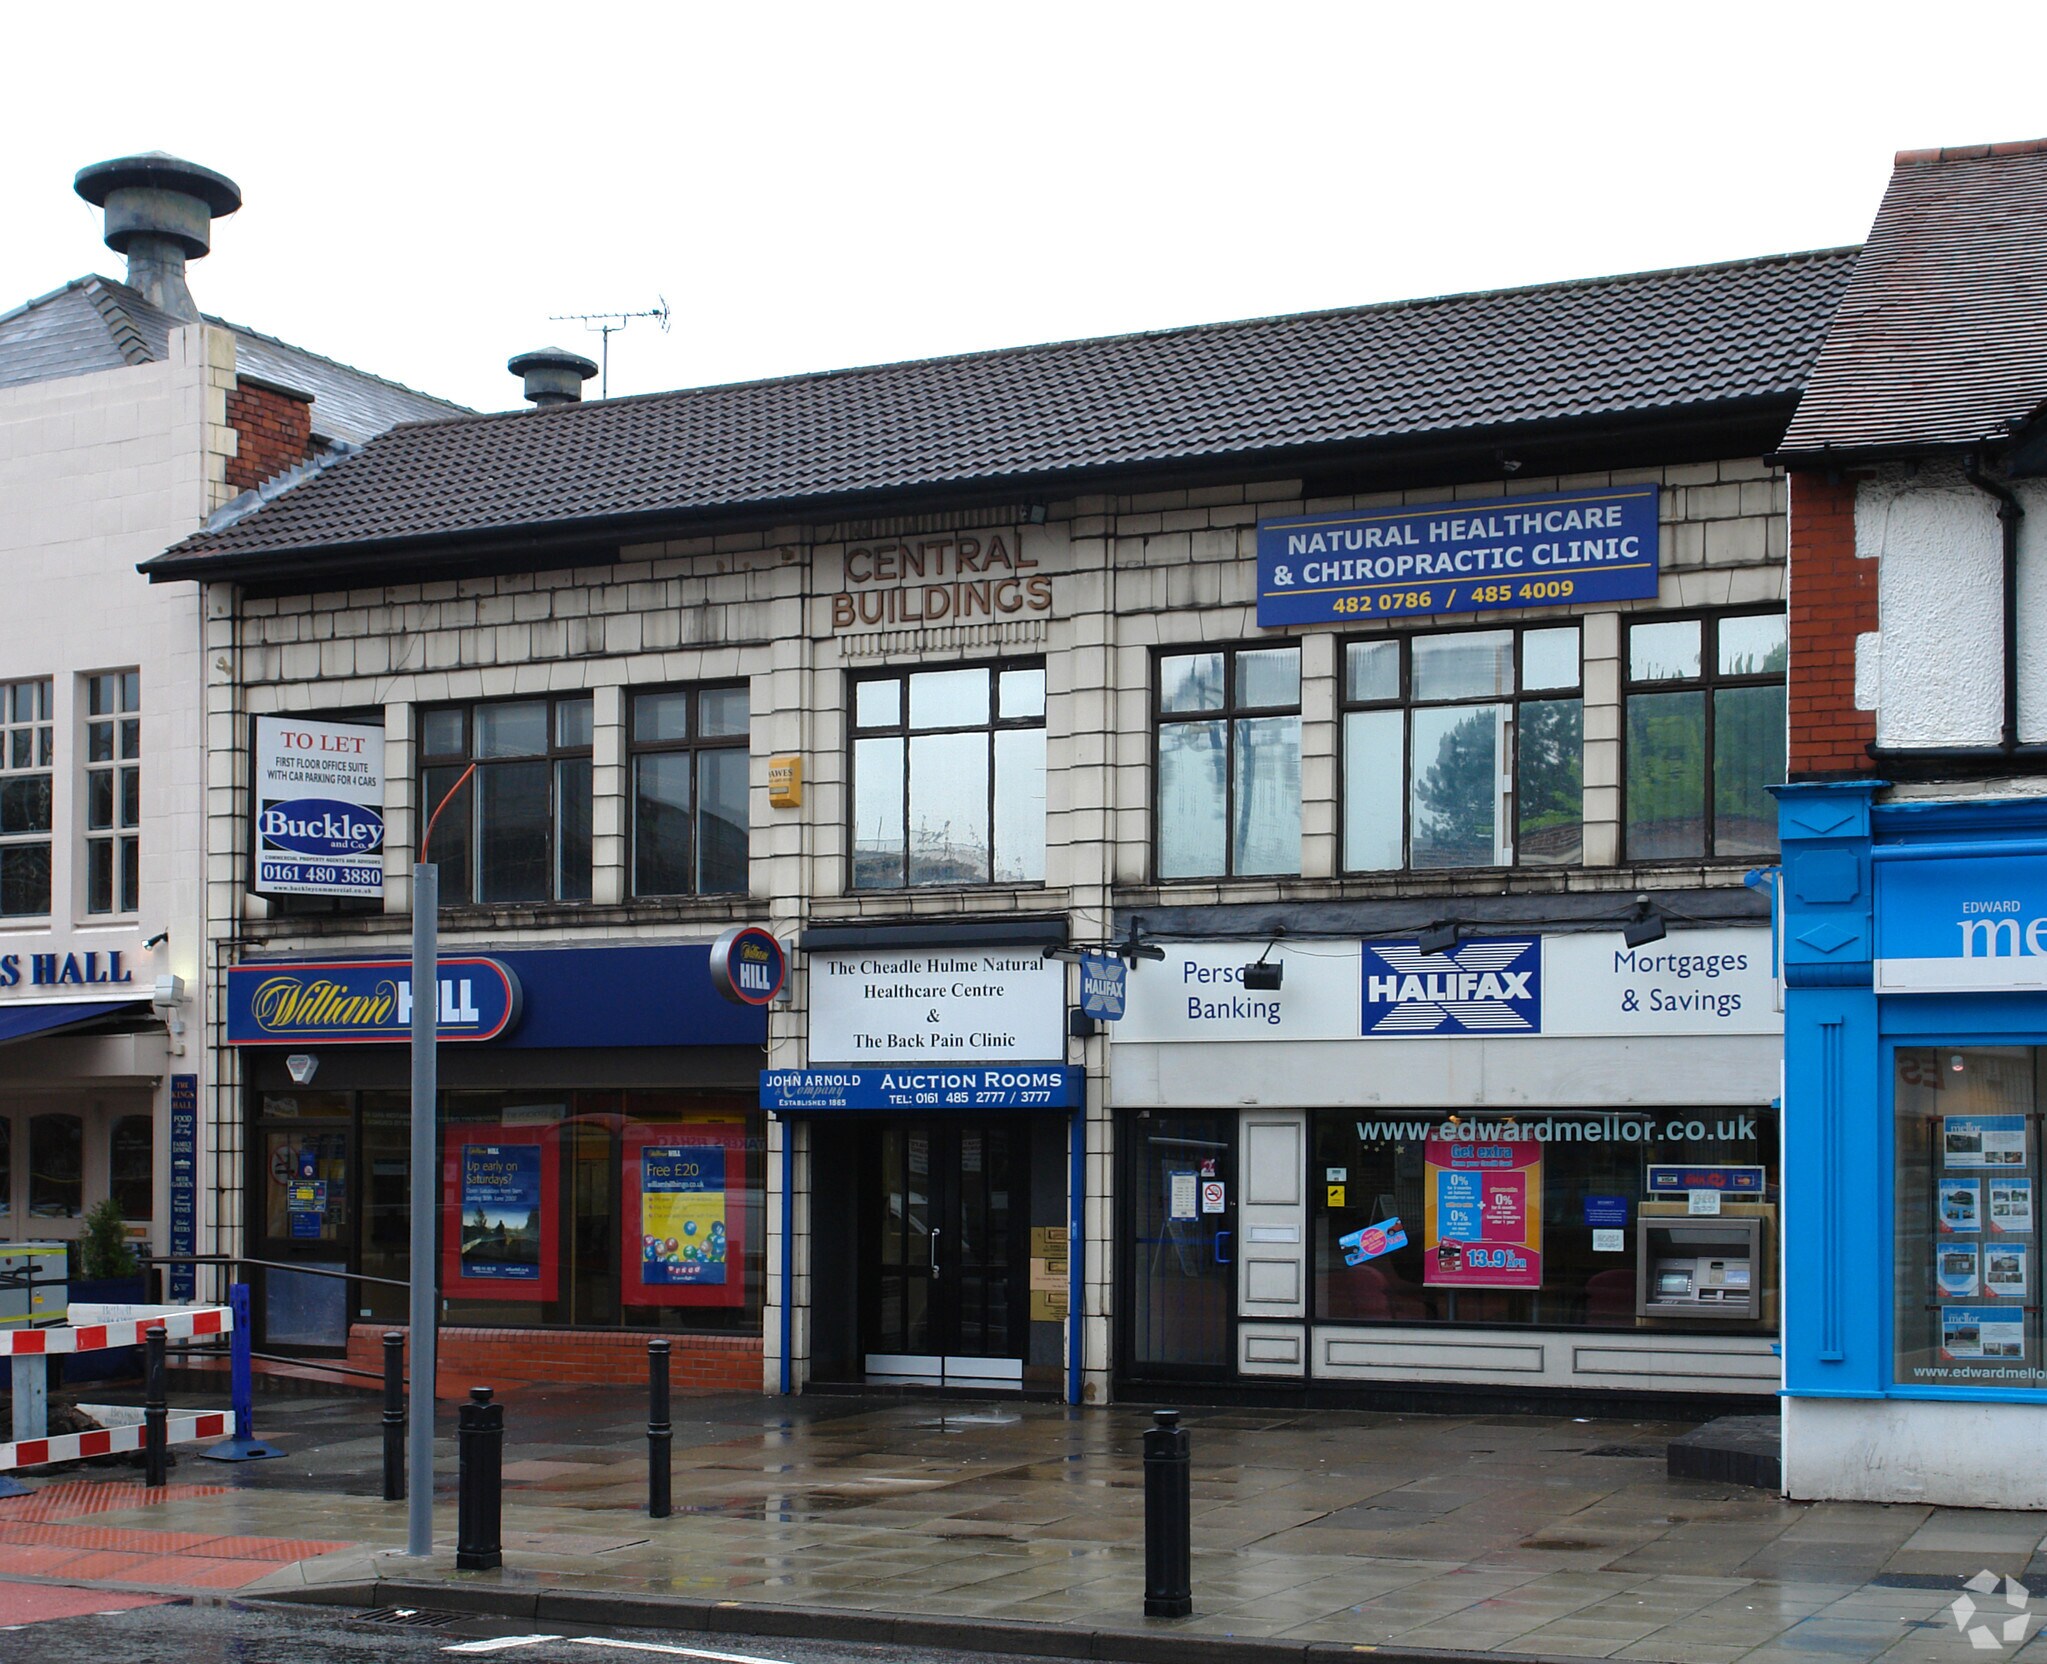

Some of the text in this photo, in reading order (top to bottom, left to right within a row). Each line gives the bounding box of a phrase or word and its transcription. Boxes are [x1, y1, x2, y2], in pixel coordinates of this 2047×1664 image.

[1288, 505, 1622, 555] NATURAL HEALTHCARE
[844, 532, 1038, 582] CENTRAL
[1273, 536, 1639, 586] & CHIROPRACTIC CLINIC
[831, 575, 1053, 628] BUILDINGS
[1333, 580, 1574, 613] 482 0786 / 485 4009
[280, 732, 366, 753] TO LET
[276, 757, 368, 773] FIRST FLOOR OFFICE SUITE
[267, 770, 376, 787] WITH CAR PARKING FOR 4 CARS
[264, 810, 384, 849] Buckley
[331, 840, 367, 849] and Co.
[263, 864, 381, 885] 0161 480 3880
[273, 885, 372, 894] www.buckleycommercial.co.uk
[1962, 900, 2021, 914] EDWARD
[741, 941, 769, 961] William
[30, 951, 132, 985] HALL
[827, 957, 1045, 975] The Cheadle Hulme Natural
[1184, 959, 1283, 983] Persol
[1614, 950, 1748, 978] Mortgages
[740, 963, 771, 990] HILL
[863, 982, 1005, 1000] Healthcare Centre
[1085, 978, 1123, 998] HALIFAX
[1368, 971, 1532, 1003] HALIFAX
[252, 976, 479, 1028] William HLL
[1188, 996, 1282, 1025] Banking
[1621, 988, 1742, 1017] & Savings
[926, 1009, 940, 1023] &
[853, 1033, 1015, 1048] The Back Pain Clinic
[766, 1075, 861, 1086] JOHN ARNOLD
[783, 1071, 845, 1098] Company
[880, 1071, 1062, 1089] AUCTION ROOMS
[173, 1101, 192, 1109] HALL
[779, 1098, 846, 1106] ESTABLISHED 1865
[889, 1091, 1050, 1104] TEL: 0161 485 2777 / 3777
[1356, 1115, 1757, 1142] www.edwardmellor.co.uk
[1451, 1145, 1513, 1158] Get extra
[467, 1160, 518, 1173] Up early on
[647, 1163, 699, 1176] Free £20
[466, 1173, 514, 1187] Saturdays?
[1450, 1174, 1469, 1186] 0%
[1495, 1194, 1513, 1206] 0%
[1450, 1210, 1469, 1222] 0%
[1466, 1249, 1506, 1268] 13.9
[1506, 1259, 1527, 1268] APR
[1948, 1312, 1980, 1323] mellor
